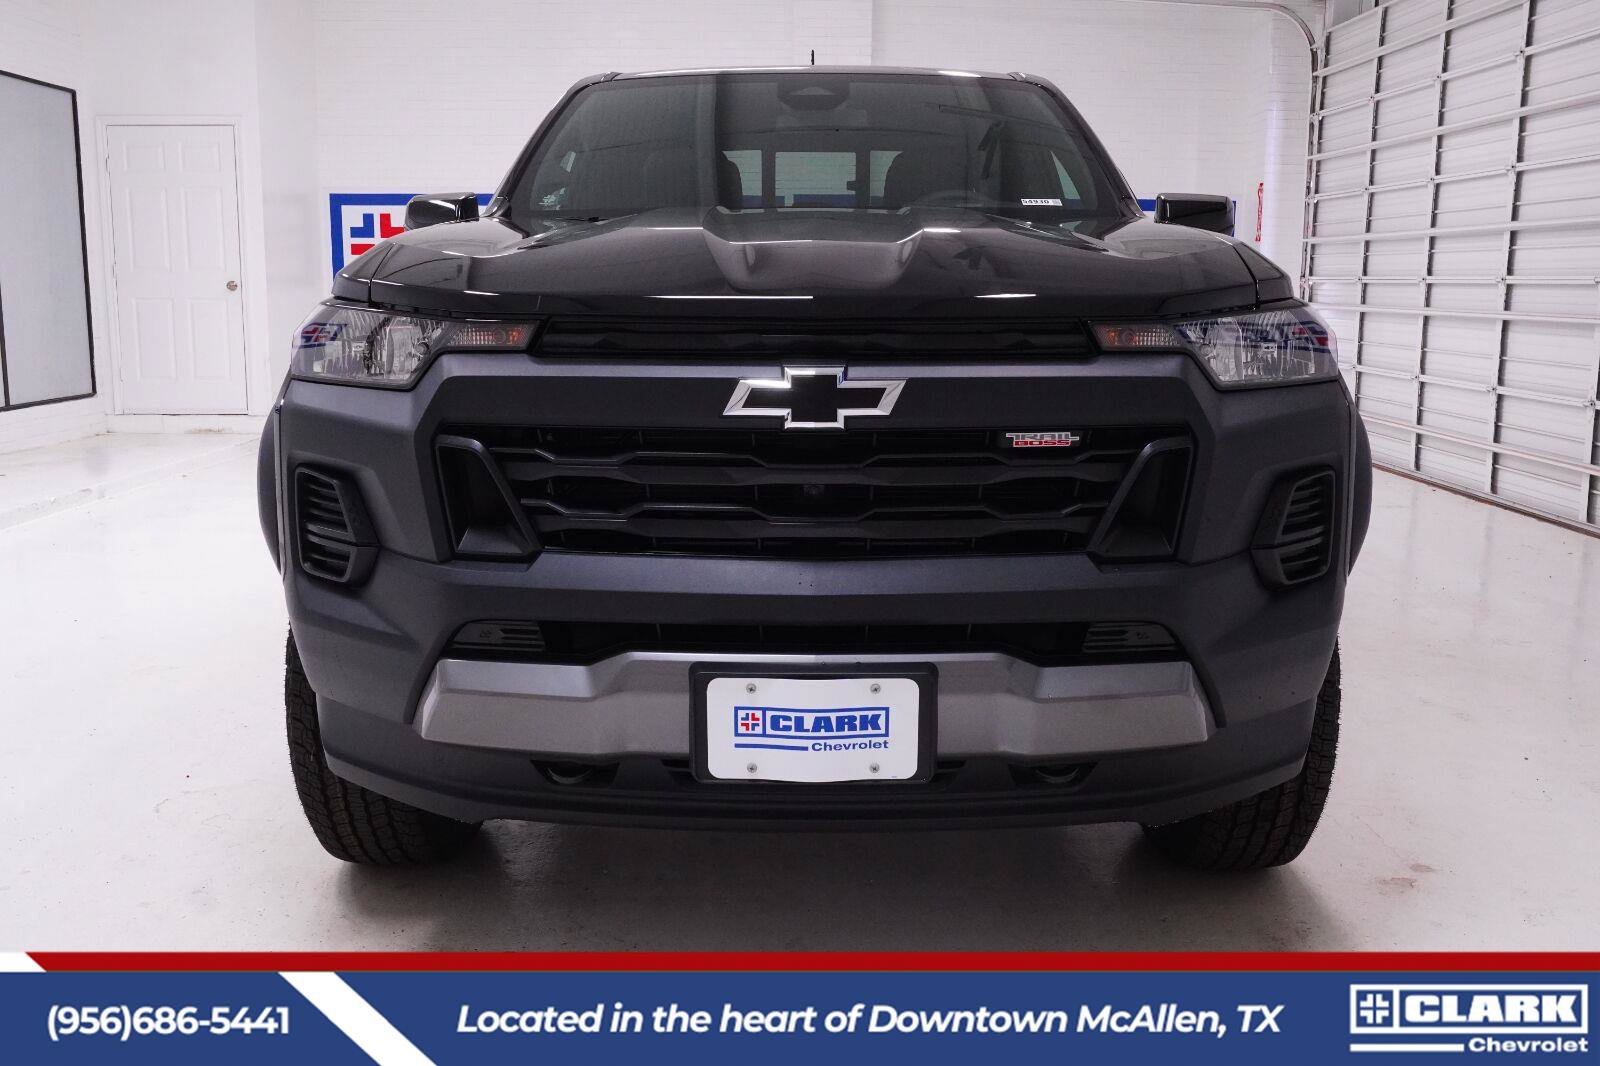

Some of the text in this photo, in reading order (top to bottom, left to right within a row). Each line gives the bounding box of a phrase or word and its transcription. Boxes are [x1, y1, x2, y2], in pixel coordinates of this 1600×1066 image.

[1006, 432, 1079, 441] TRAIL
[1013, 439, 1071, 447] BOSS
[770, 713, 882, 733] CLARK
[811, 739, 889, 752] Chevrolet
